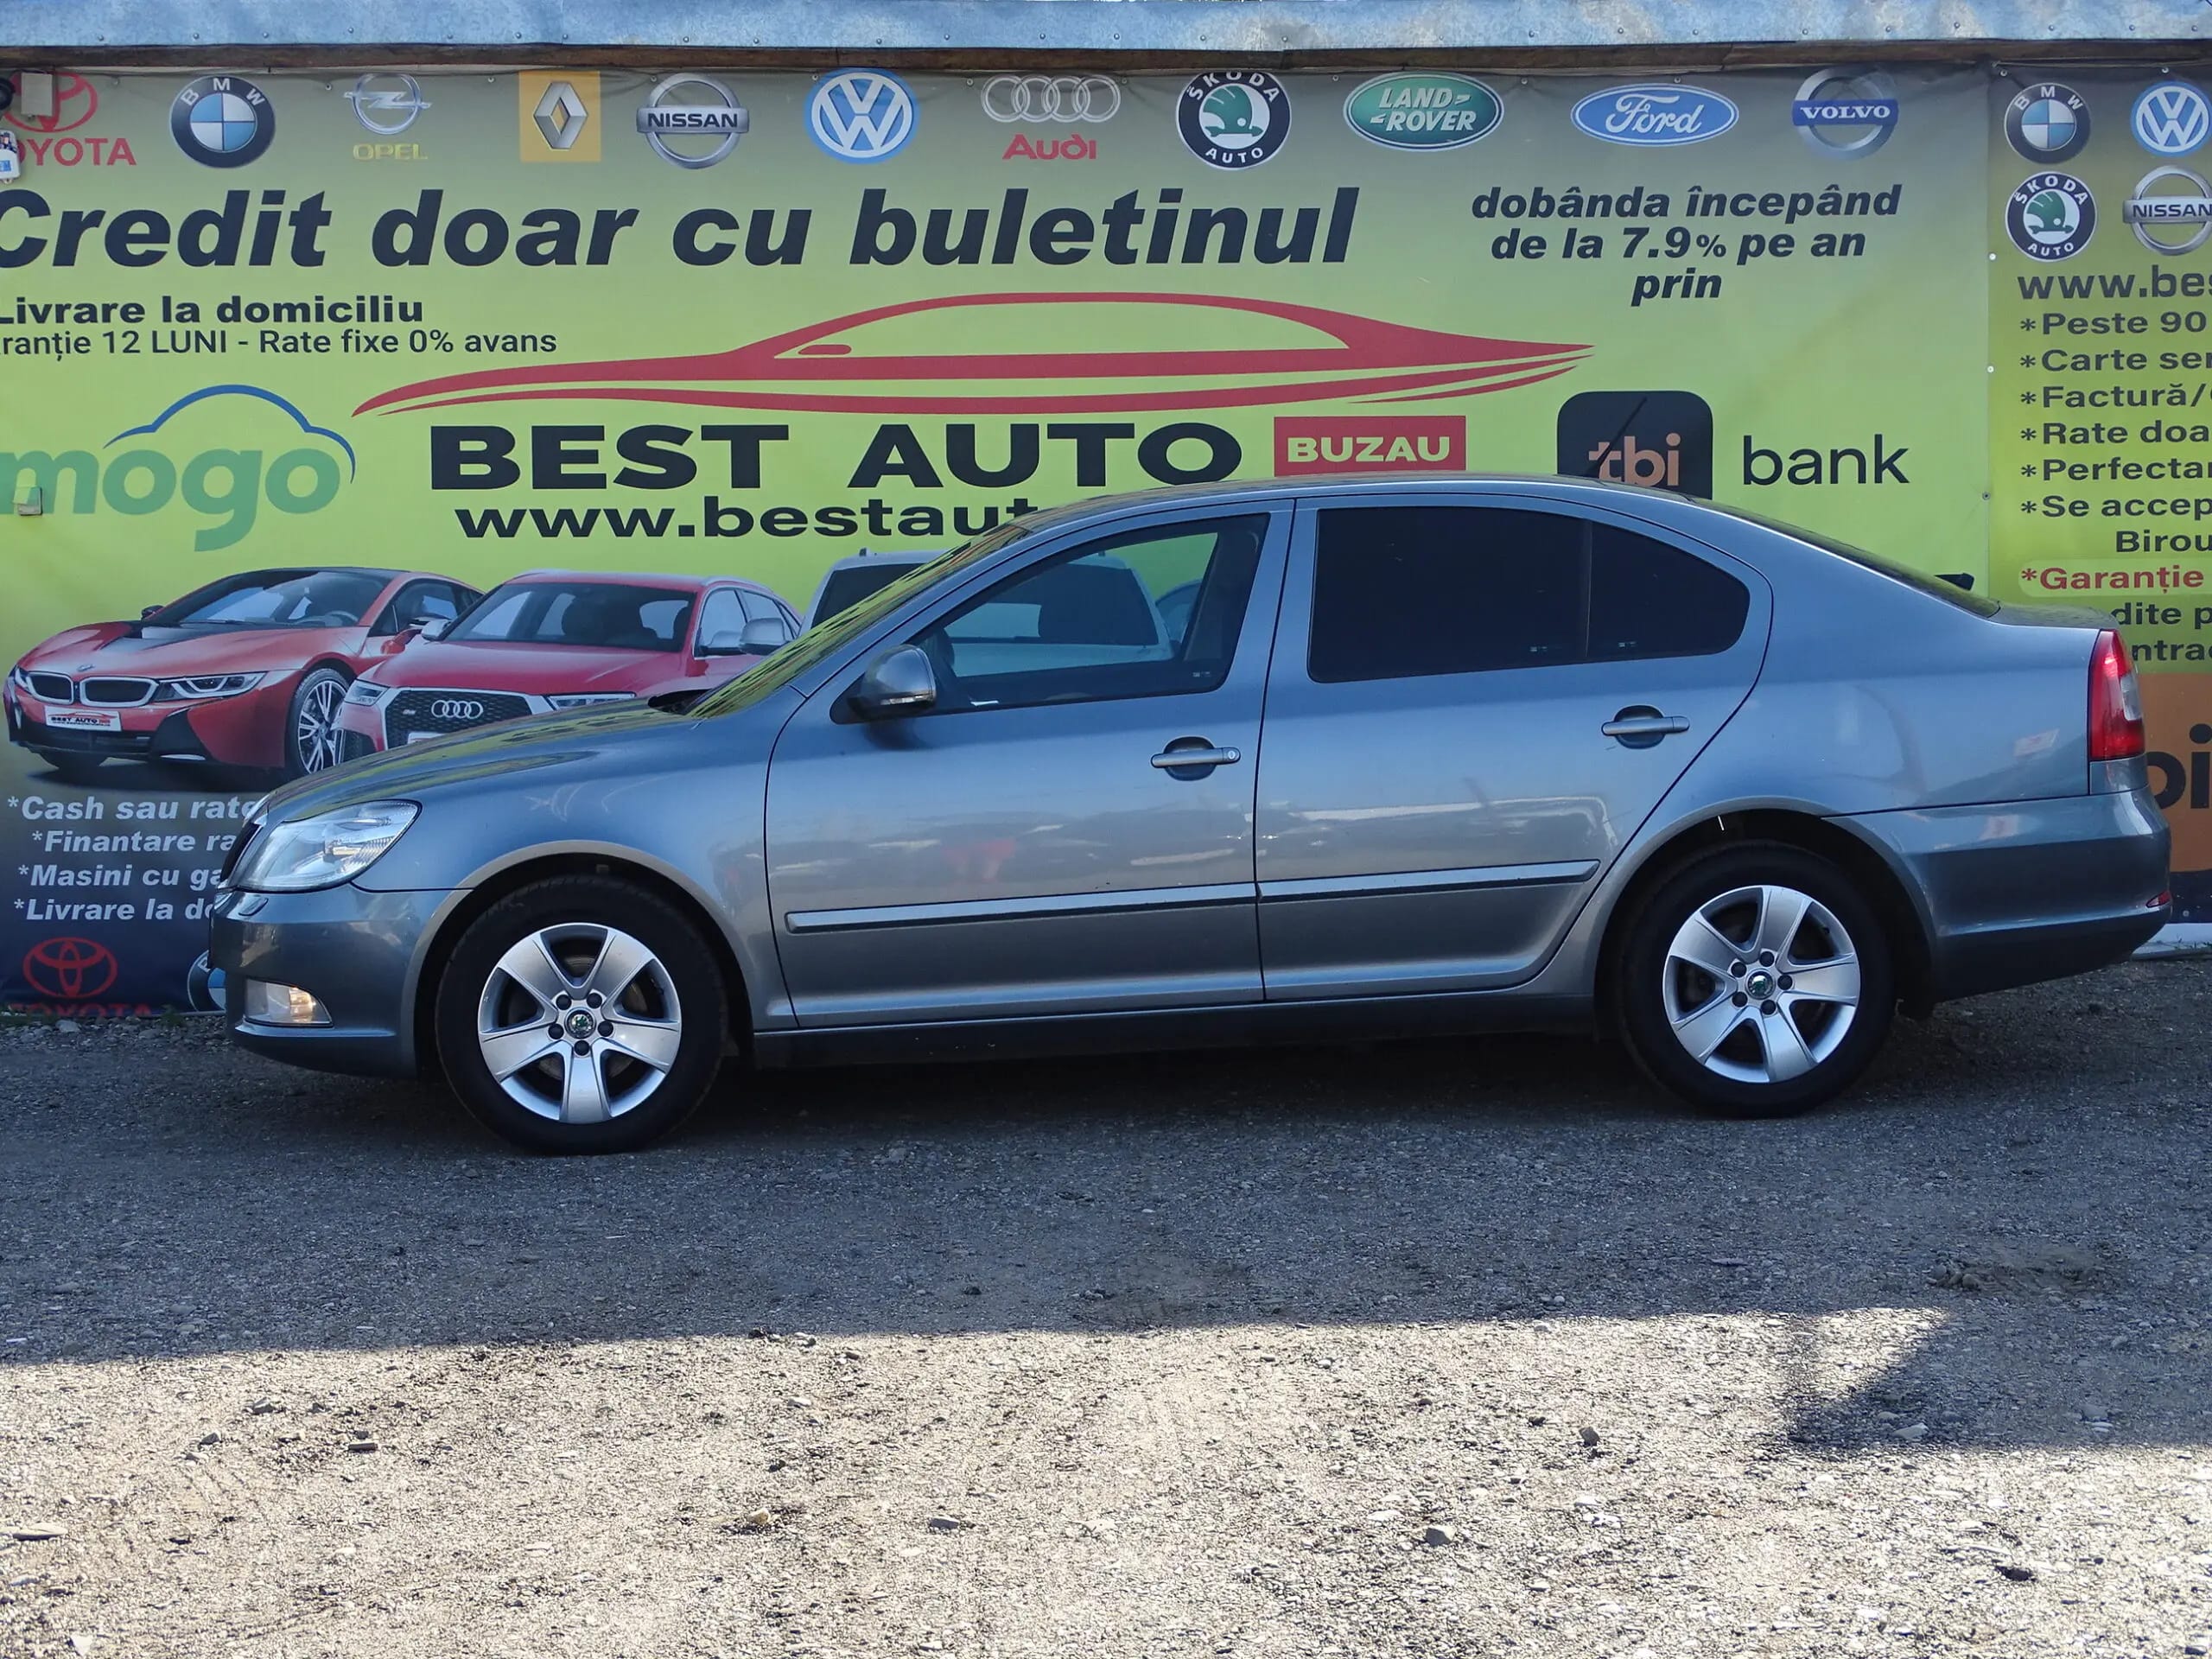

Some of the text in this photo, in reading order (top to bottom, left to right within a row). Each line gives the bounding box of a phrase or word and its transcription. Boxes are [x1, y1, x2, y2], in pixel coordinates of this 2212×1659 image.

[181, 76, 265, 106] BMW
[2014, 86, 2083, 111] BMW
[647, 111, 739, 130] NISSAN
[1605, 92, 1706, 134] Ford
[1800, 104, 1891, 120] VOLVO
[17, 137, 137, 166] YOTA
[353, 143, 428, 162] OPEL
[1002, 133, 1096, 160] Audi
[1205, 147, 1263, 164] AUTO
[1471, 184, 1903, 224] dobânda începând
[2133, 203, 2212, 218] NISSAN
[0, 187, 1360, 269] Credit doar cu buletinul
[1491, 228, 1547, 259] de
[1562, 228, 1603, 258] la
[1737, 232, 1796, 265] pe
[1810, 232, 1866, 257] an
[2027, 242, 2074, 257] AUTO
[1630, 267, 1722, 307] prin
[2018, 264, 2212, 300] www.be
[162, 296, 200, 323] la
[216, 295, 423, 323] domiciliu
[2160, 310, 2208, 334] 90
[102, 330, 141, 353] 12
[152, 330, 226, 353] LUNI
[259, 329, 332, 353] Rate
[341, 328, 398, 353] fixe
[409, 328, 454, 353] 0%
[467, 332, 557, 353] avans
[2020, 383, 2212, 408] Factură/
[431, 422, 1243, 490] BEST AUTO
[1287, 435, 1450, 462] BUZAU
[1588, 432, 1681, 487] tbi
[1743, 434, 1911, 486] bank
[2020, 456, 2212, 480] Perfecta
[0, 448, 340, 552] mogo
[2101, 497, 2212, 521] accep
[2116, 529, 2212, 552] Birou
[2132, 640, 2212, 661] ntra
[116, 801, 179, 820] sau
[142, 869, 180, 886] cu
[146, 899, 174, 920] la
